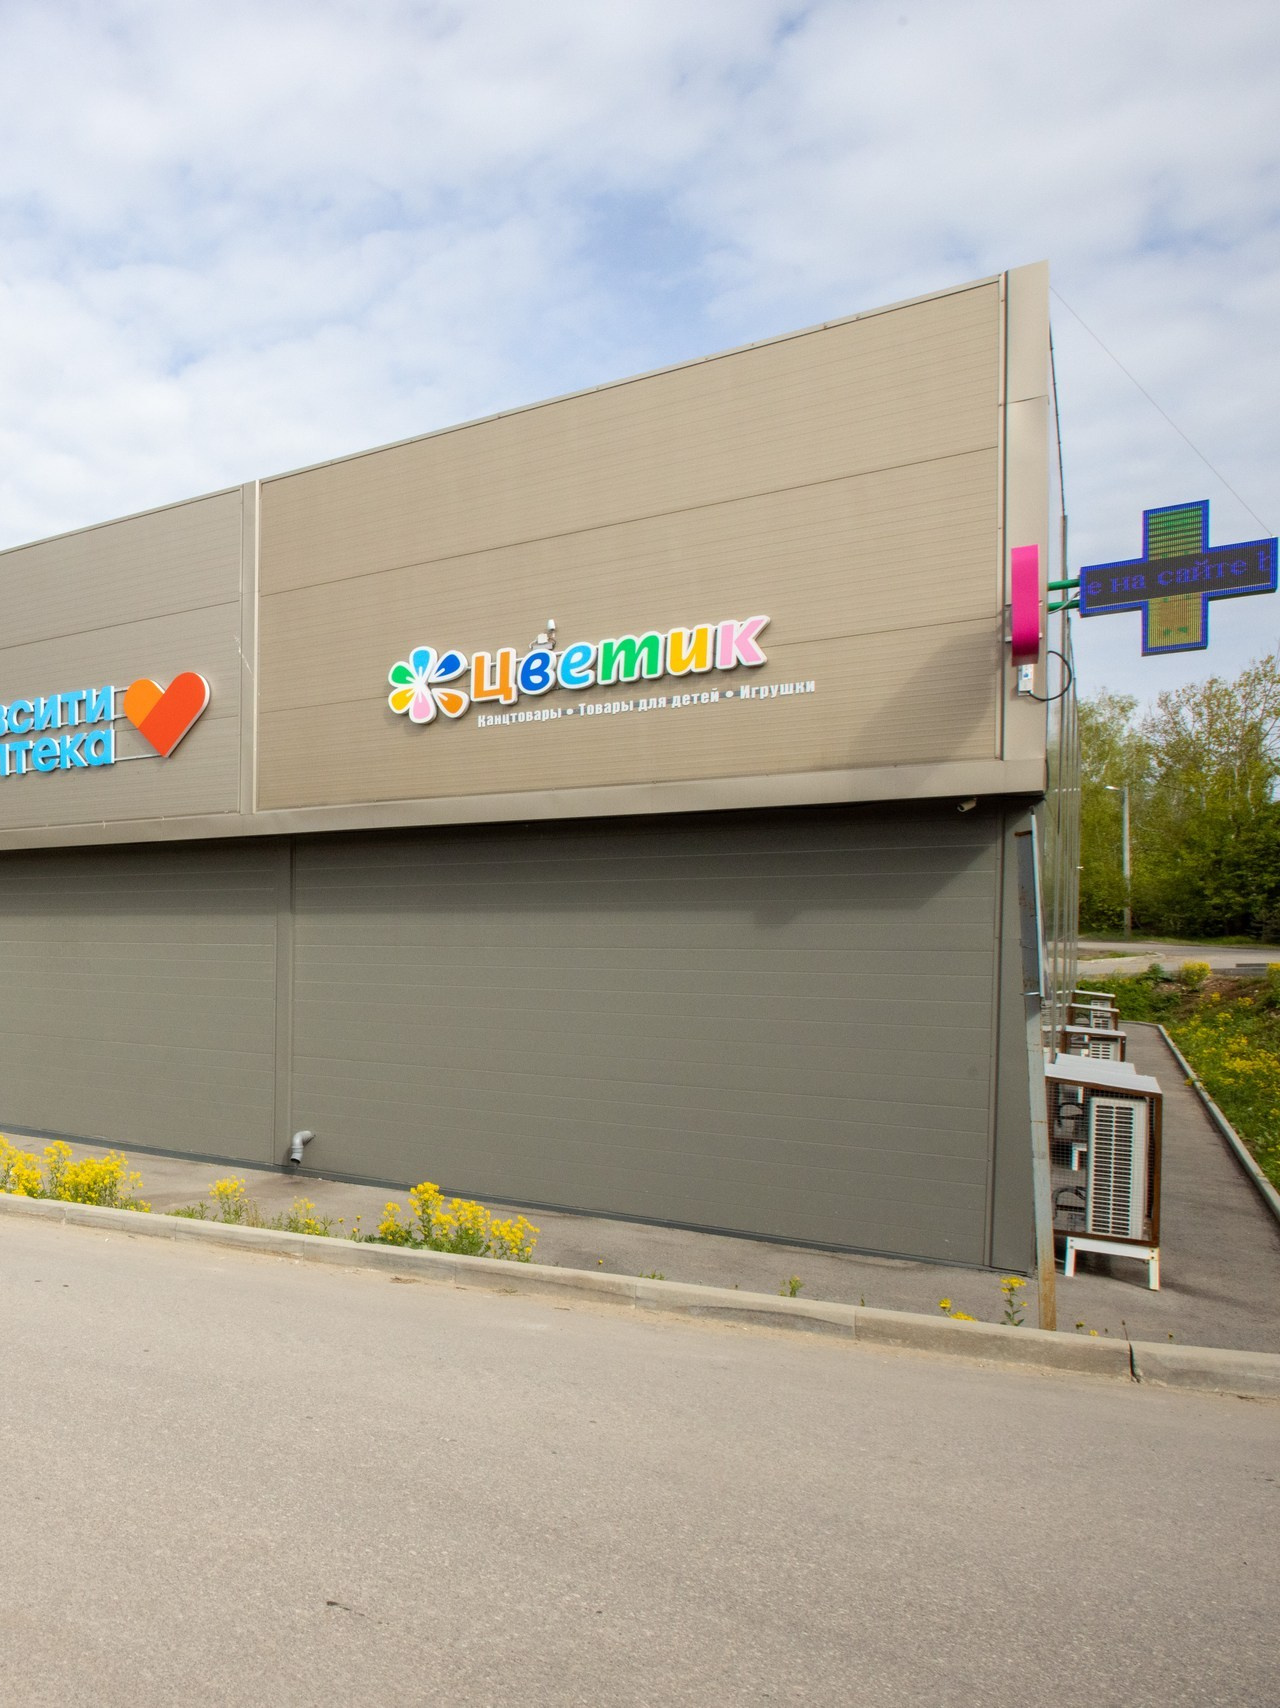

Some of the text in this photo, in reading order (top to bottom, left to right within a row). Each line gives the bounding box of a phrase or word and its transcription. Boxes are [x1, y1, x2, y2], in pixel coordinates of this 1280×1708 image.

[1111, 574, 1146, 594] на
[1157, 558, 1247, 586] сайте
[477, 678, 816, 728] Канцтовары Товары для детей Игрушки
